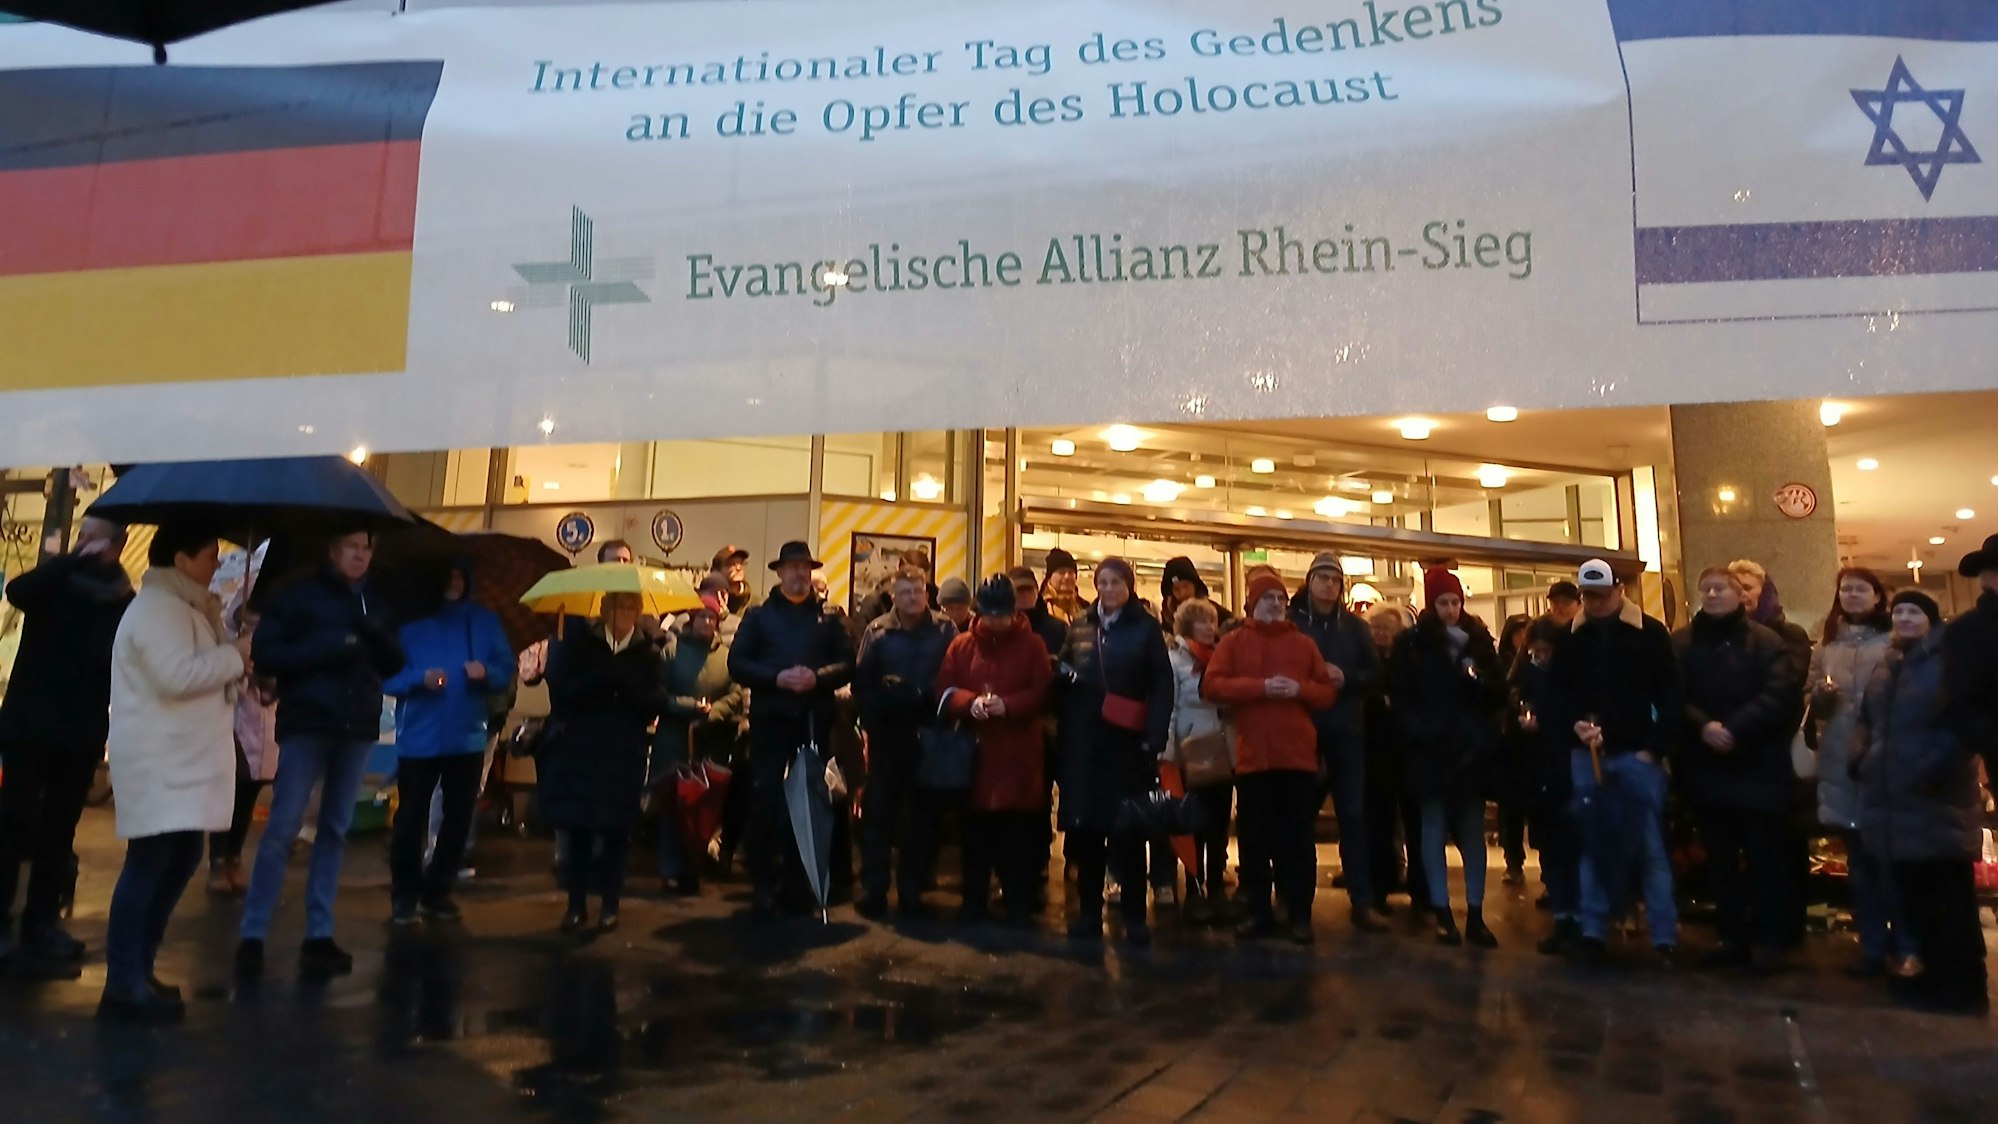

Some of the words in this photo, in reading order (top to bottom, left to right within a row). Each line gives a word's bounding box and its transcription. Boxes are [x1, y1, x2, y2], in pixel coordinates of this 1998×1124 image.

[528, 46, 943, 93] Internationaler
[965, 40, 1052, 76] Tag
[1078, 32, 1167, 65] des
[1190, 0, 1504, 57] Gedenkens
[625, 111, 691, 142] an
[715, 101, 798, 138] die
[822, 93, 970, 142] Opfer
[993, 88, 1084, 127] des
[1107, 70, 1399, 118] Holocaust
[685, 240, 1022, 307] Evangelische
[1036, 233, 1222, 285] Allianz
[1237, 219, 1533, 281] Rhein-Sieg
